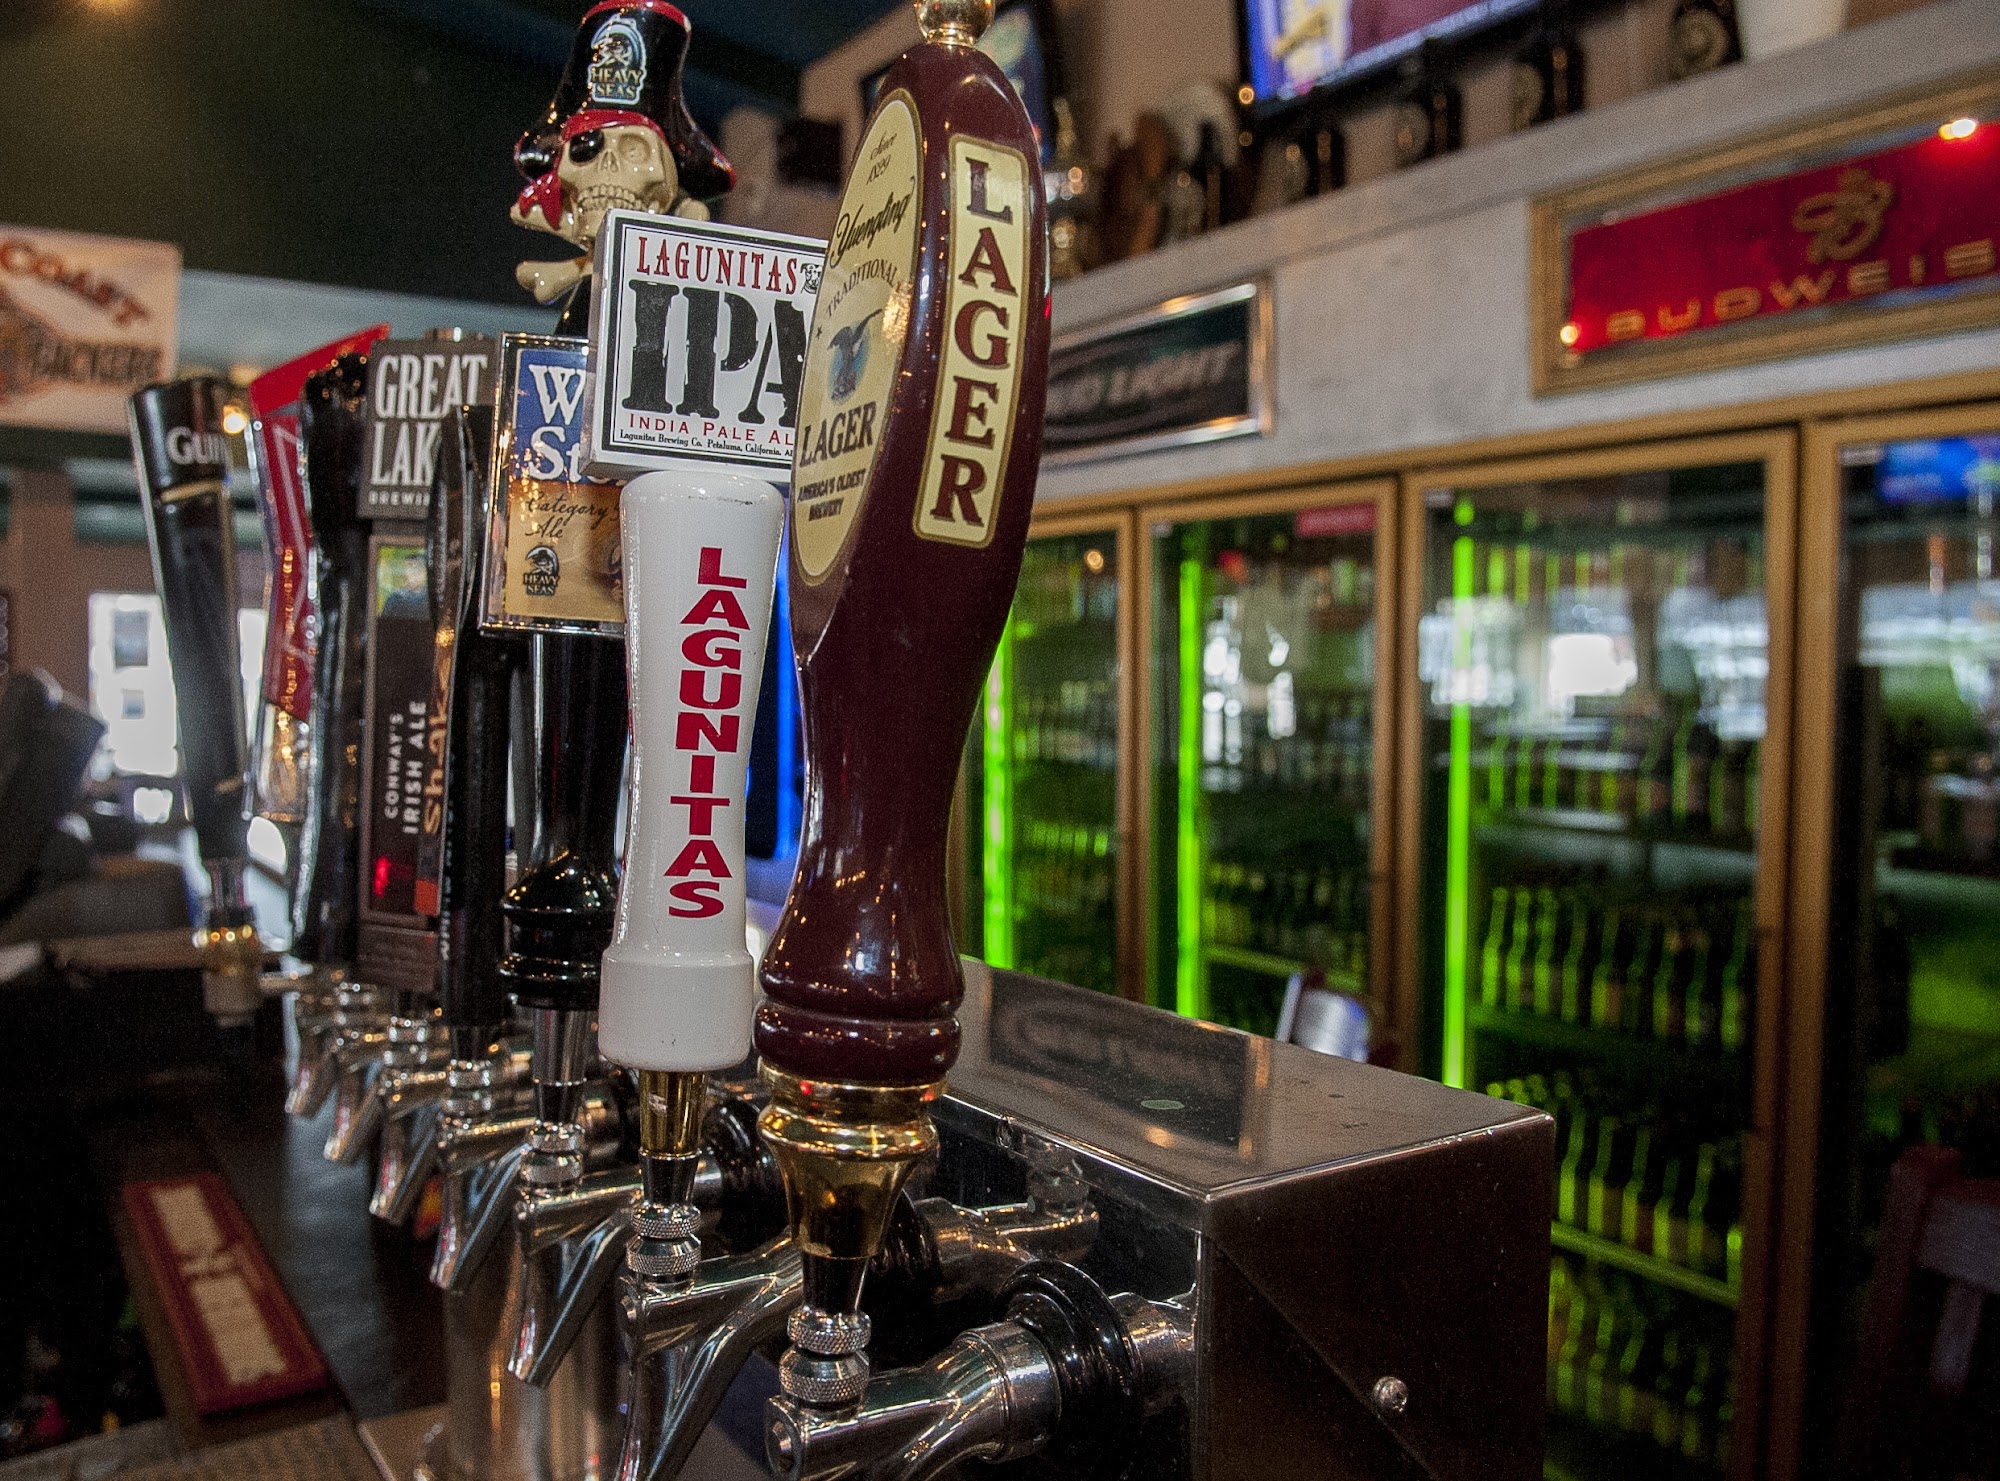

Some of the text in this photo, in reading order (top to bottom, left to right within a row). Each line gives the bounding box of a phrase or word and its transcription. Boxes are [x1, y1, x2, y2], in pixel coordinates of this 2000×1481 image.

[591, 67, 642, 85] HEAVY
[596, 83, 637, 98] SEAS
[829, 175, 915, 269] Yuengling
[636, 236, 798, 295] LAGUNITAS
[826, 258, 899, 318] TRADITIONAL
[621, 279, 807, 428] IPA
[929, 157, 1018, 528] LAGER
[375, 354, 488, 419] GREAT
[371, 422, 442, 486] LAK
[620, 429, 656, 443] Lagunitas
[658, 433, 689, 447] Brewing
[691, 436, 703, 447] Co.
[629, 413, 689, 435] INDIA
[703, 421, 756, 442] PALE
[799, 401, 877, 468] LAGER
[525, 516, 563, 538] Ale
[526, 491, 608, 530] Category
[524, 573, 559, 586] HEAVY
[527, 585, 555, 595] SEAS
[663, 546, 750, 919] LAGUNITAS
[384, 713, 403, 820] CONWAY'S
[402, 701, 426, 835] IRISH ALE
